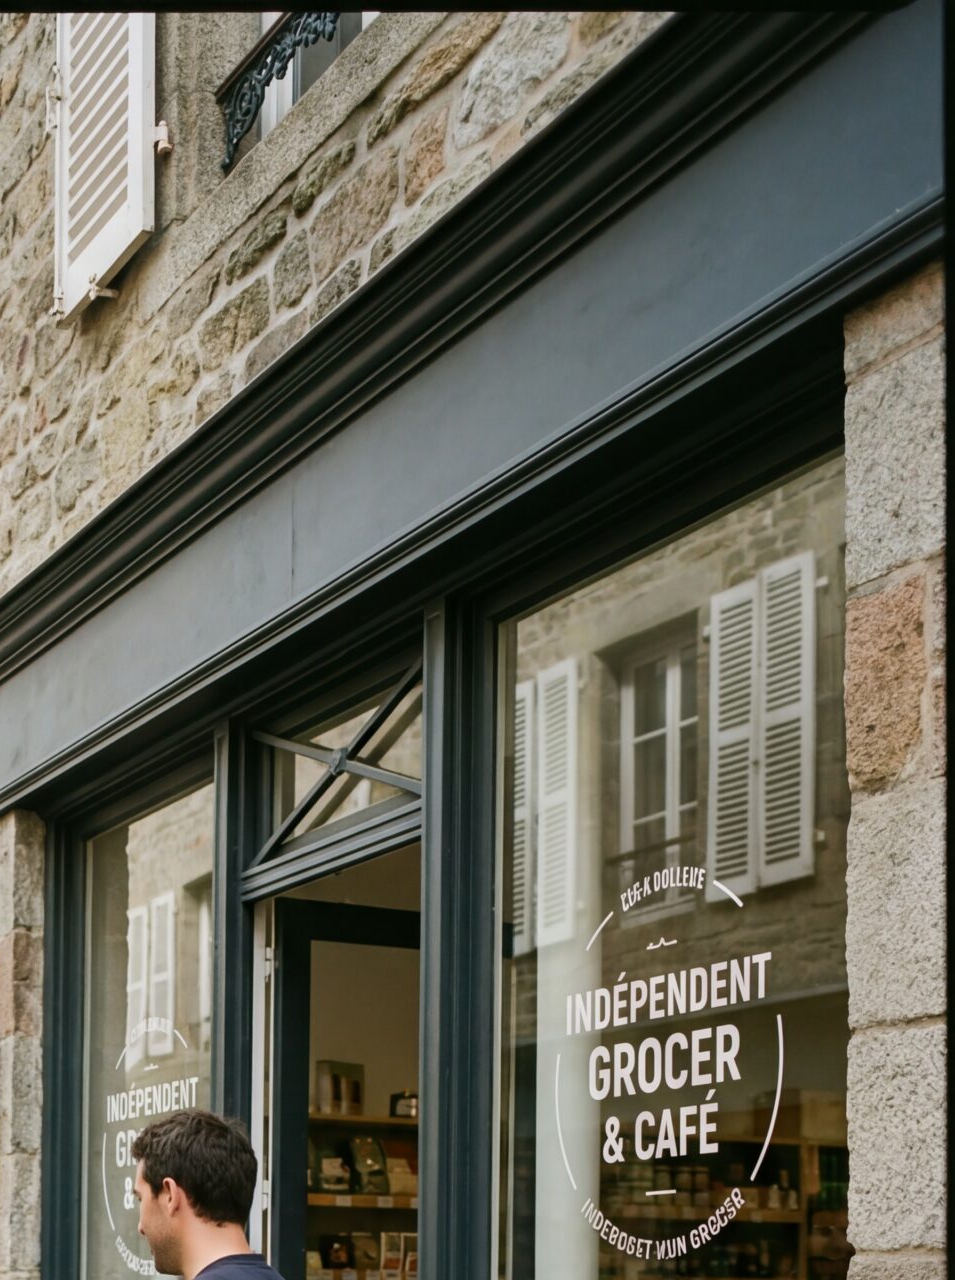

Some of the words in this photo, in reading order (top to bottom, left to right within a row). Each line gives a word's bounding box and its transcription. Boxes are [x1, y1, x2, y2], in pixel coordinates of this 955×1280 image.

[565, 951, 772, 1036] INDÉPENDENT
[106, 1077, 199, 1123] INDÉPENDENT
[588, 1023, 742, 1101] GROCER
[602, 1116, 626, 1164] &
[634, 1089, 719, 1161] CAFÉ
